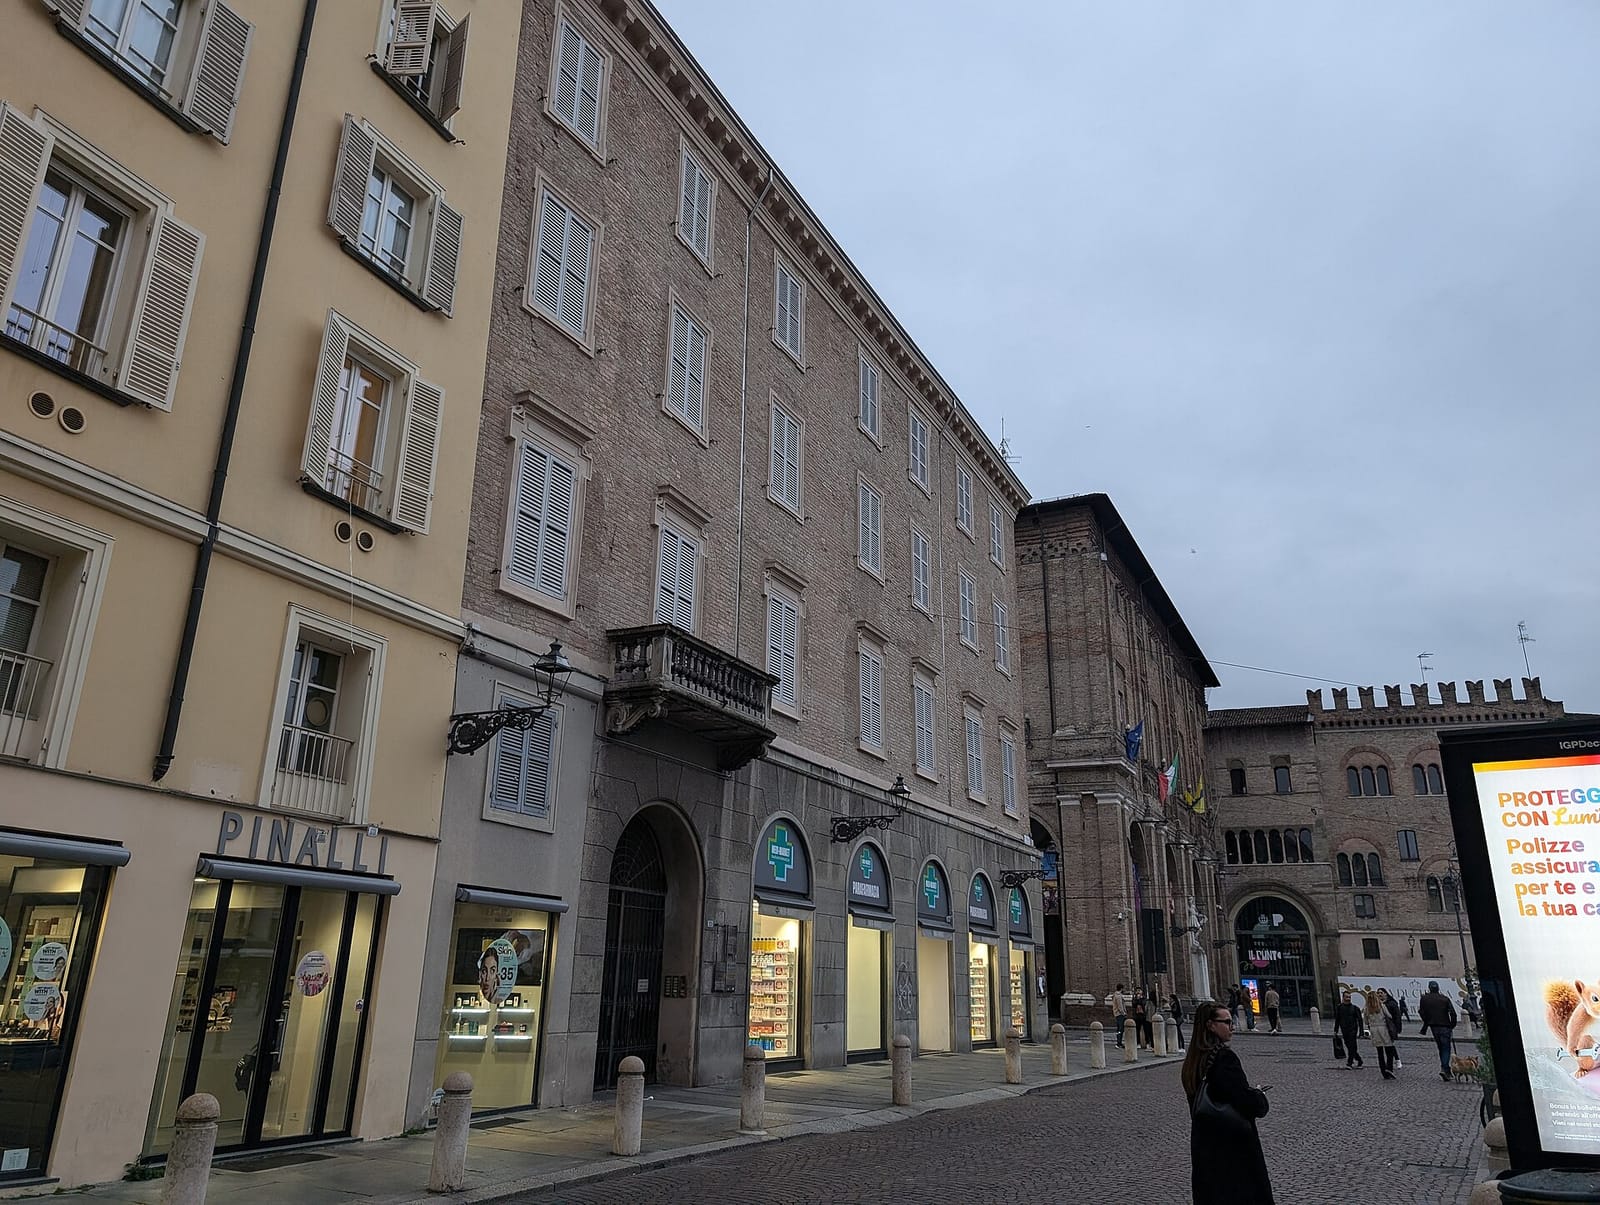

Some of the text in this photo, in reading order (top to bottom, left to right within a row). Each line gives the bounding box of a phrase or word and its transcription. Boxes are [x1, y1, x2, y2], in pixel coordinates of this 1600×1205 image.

[1497, 787, 1600, 807] PROTEGG
[1501, 810, 1549, 827] CON
[216, 810, 388, 874] PINALLI
[1506, 837, 1584, 854] Polizze
[1511, 857, 1600, 874] assicura
[1514, 880, 1595, 899] per te e
[1518, 898, 1537, 916] la
[1542, 901, 1578, 916] tua
